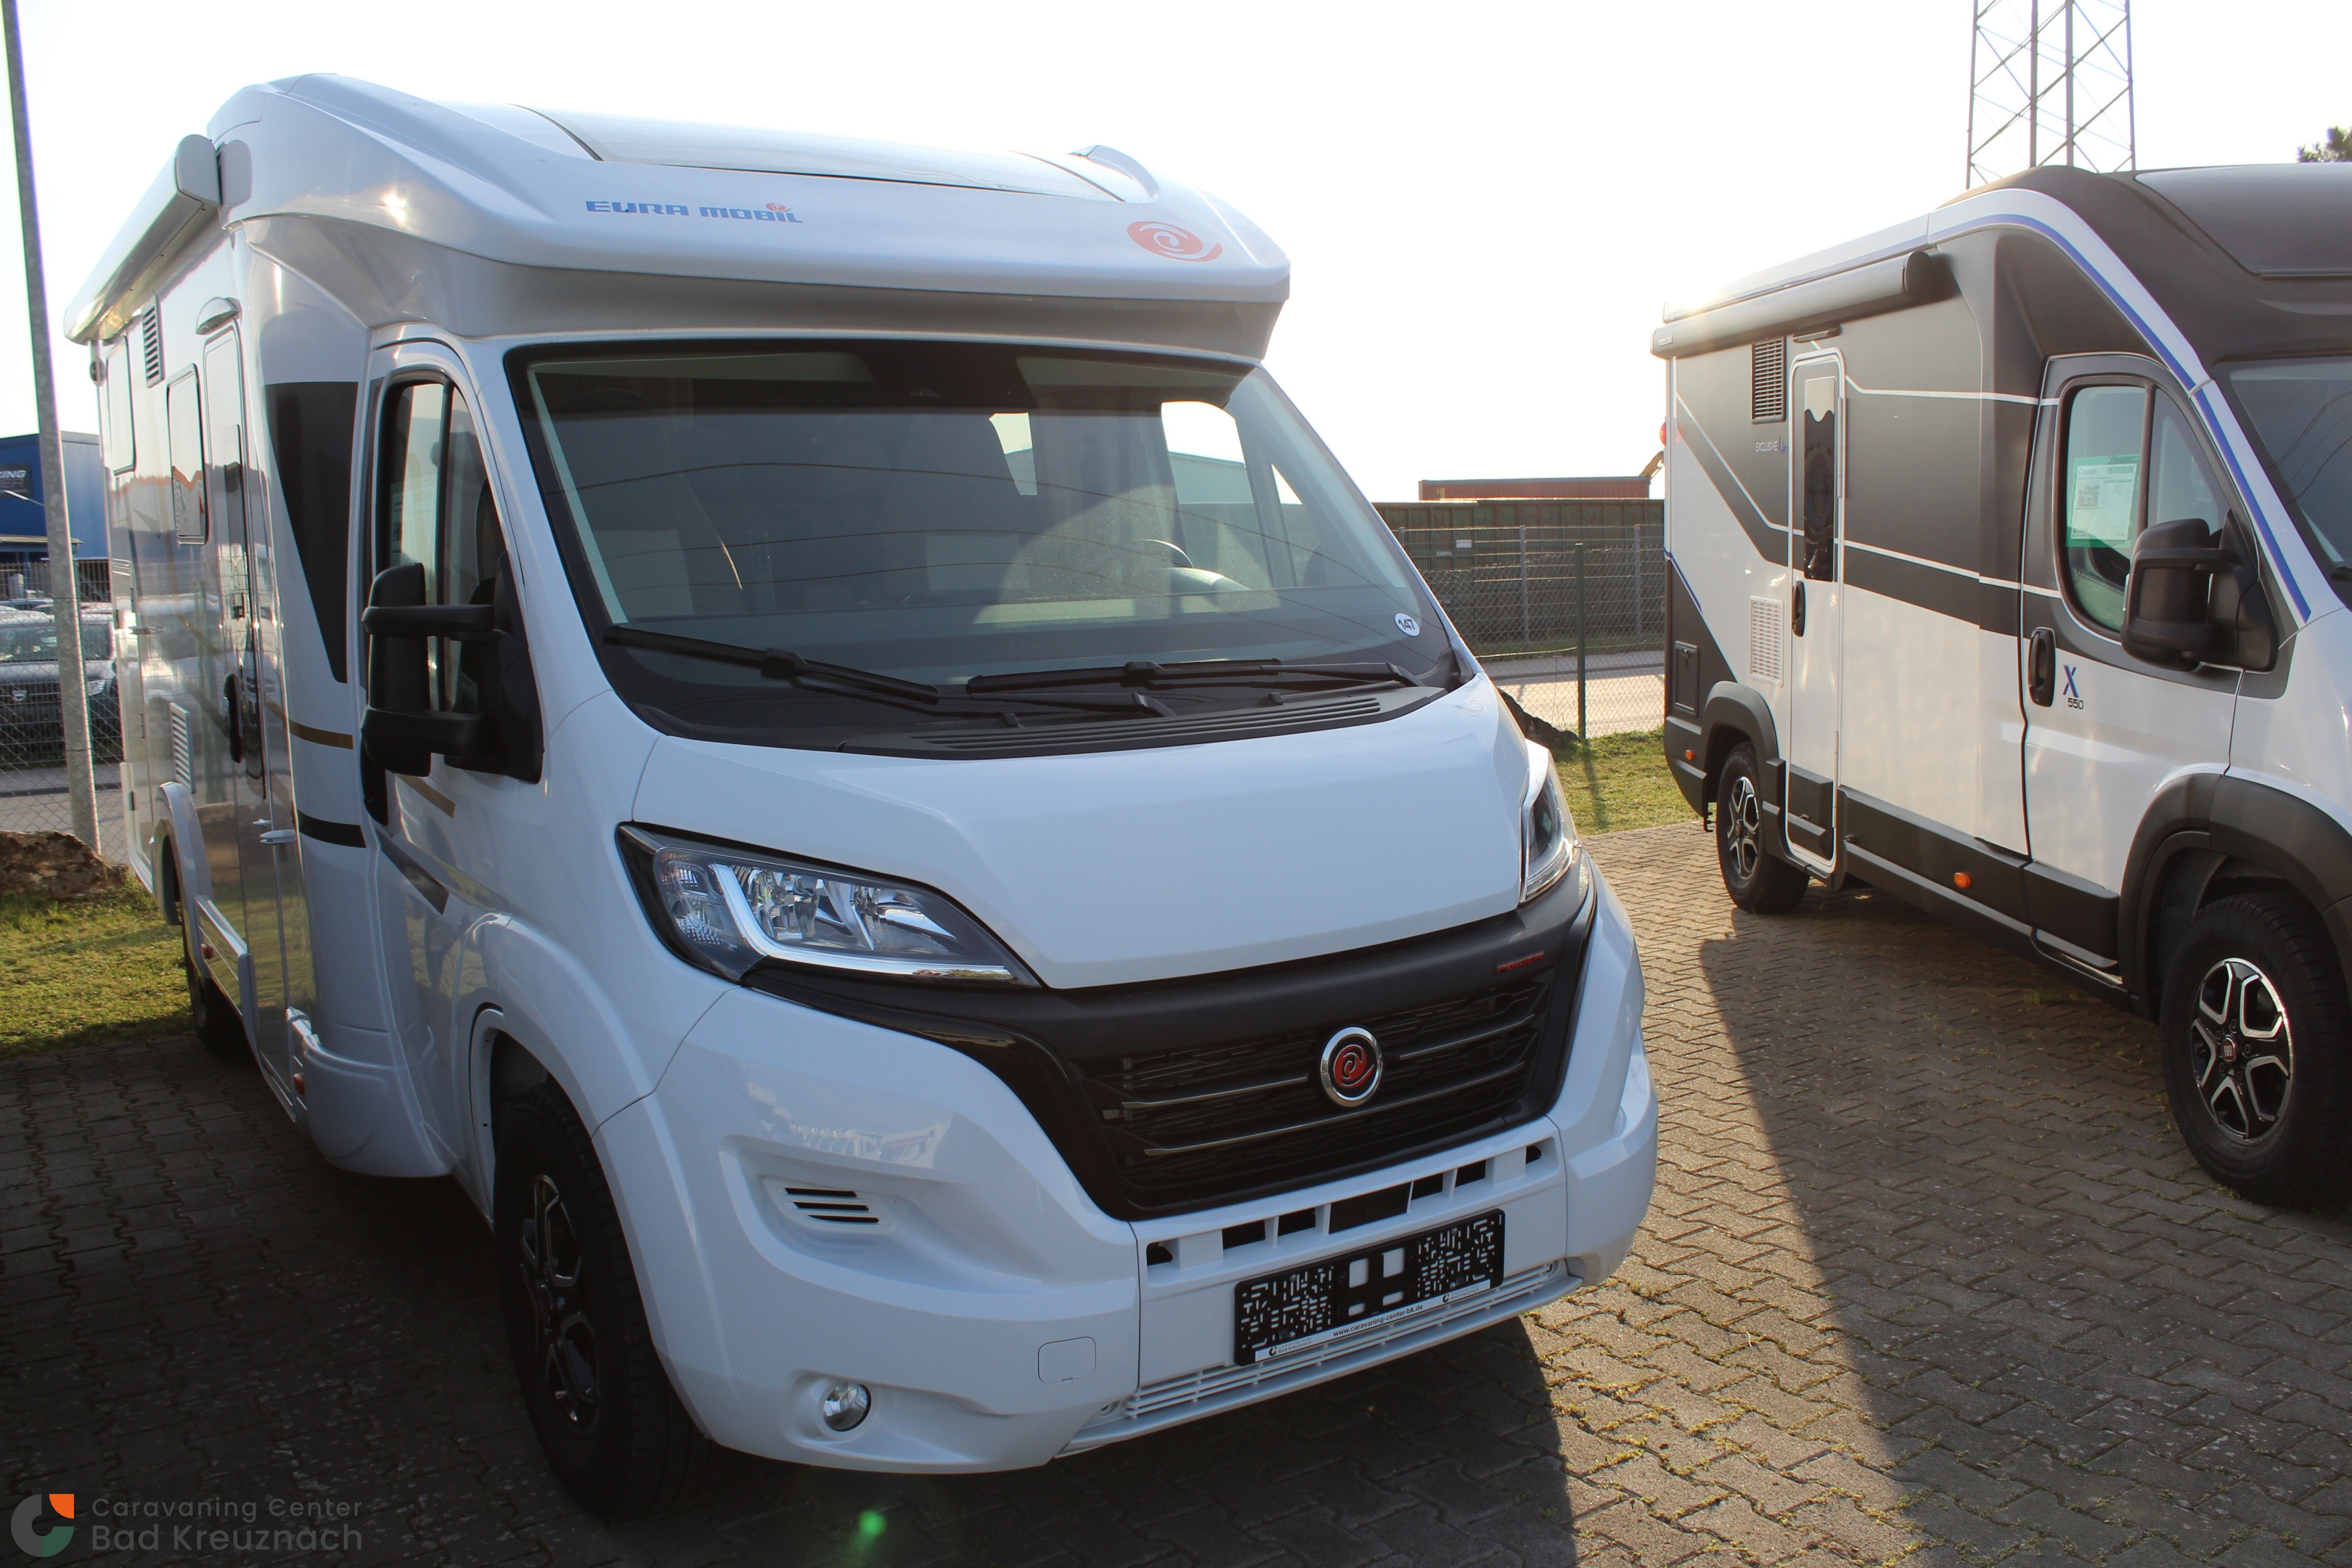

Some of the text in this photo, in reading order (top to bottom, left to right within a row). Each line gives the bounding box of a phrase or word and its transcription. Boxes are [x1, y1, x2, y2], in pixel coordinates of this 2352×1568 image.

[586, 200, 690, 216] EURA
[1397, 618, 1416, 631] 147
[2062, 663, 2079, 698] X
[2067, 697, 2084, 710] 550
[1496, 951, 1545, 974] POWER
[1333, 1304, 1424, 1337] www.caravaning-center-bk.de
